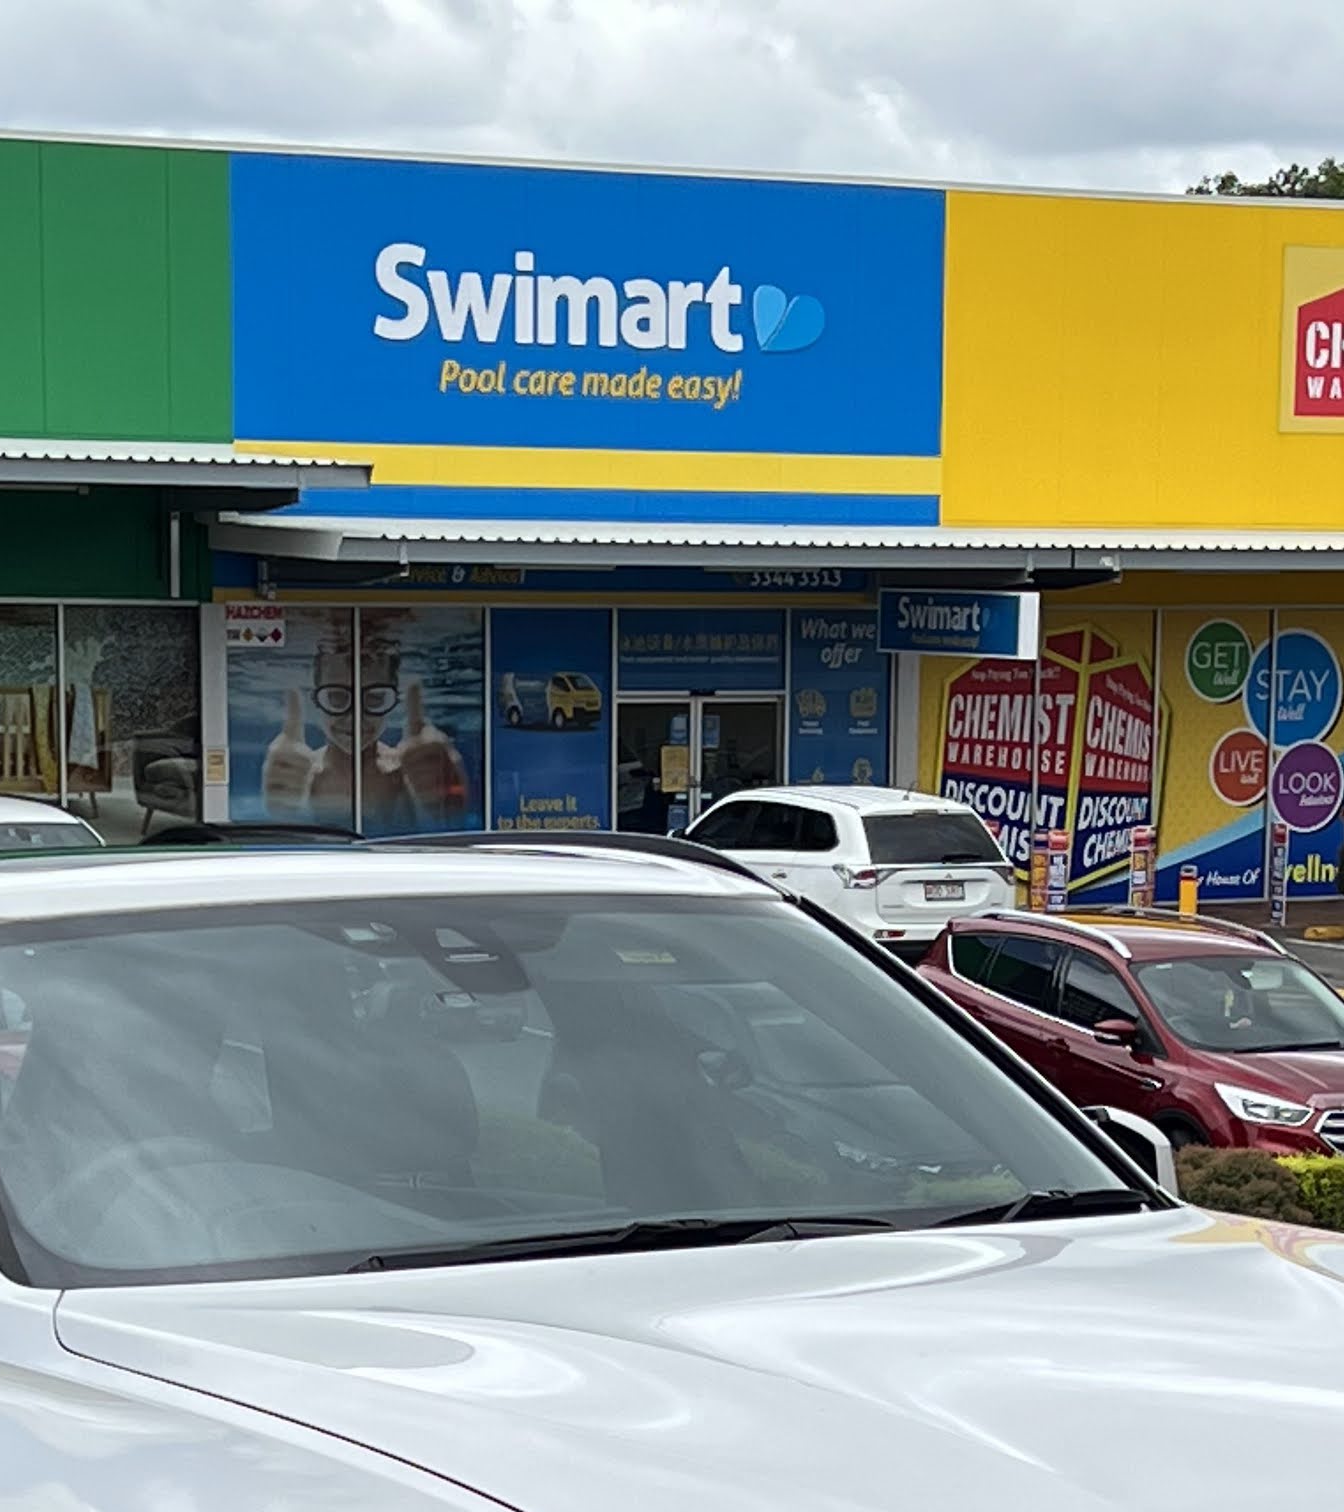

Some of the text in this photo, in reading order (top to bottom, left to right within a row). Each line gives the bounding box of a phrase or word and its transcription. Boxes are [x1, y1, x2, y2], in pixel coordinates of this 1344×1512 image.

[374, 243, 744, 352] Swimart
[439, 360, 743, 409] Pool care made easy!
[800, 619, 847, 640] What
[897, 596, 981, 632] Swimart
[821, 643, 863, 668] offer
[1191, 641, 1245, 669] GET
[1255, 669, 1330, 703] STAY
[948, 694, 1075, 745] CHEMIST
[1086, 694, 1152, 762] CHEMIS
[1219, 750, 1265, 774] LIVE
[1278, 772, 1337, 794] LOOK
[520, 794, 563, 812] Leave
[945, 779, 1064, 828] DISCOUNT
